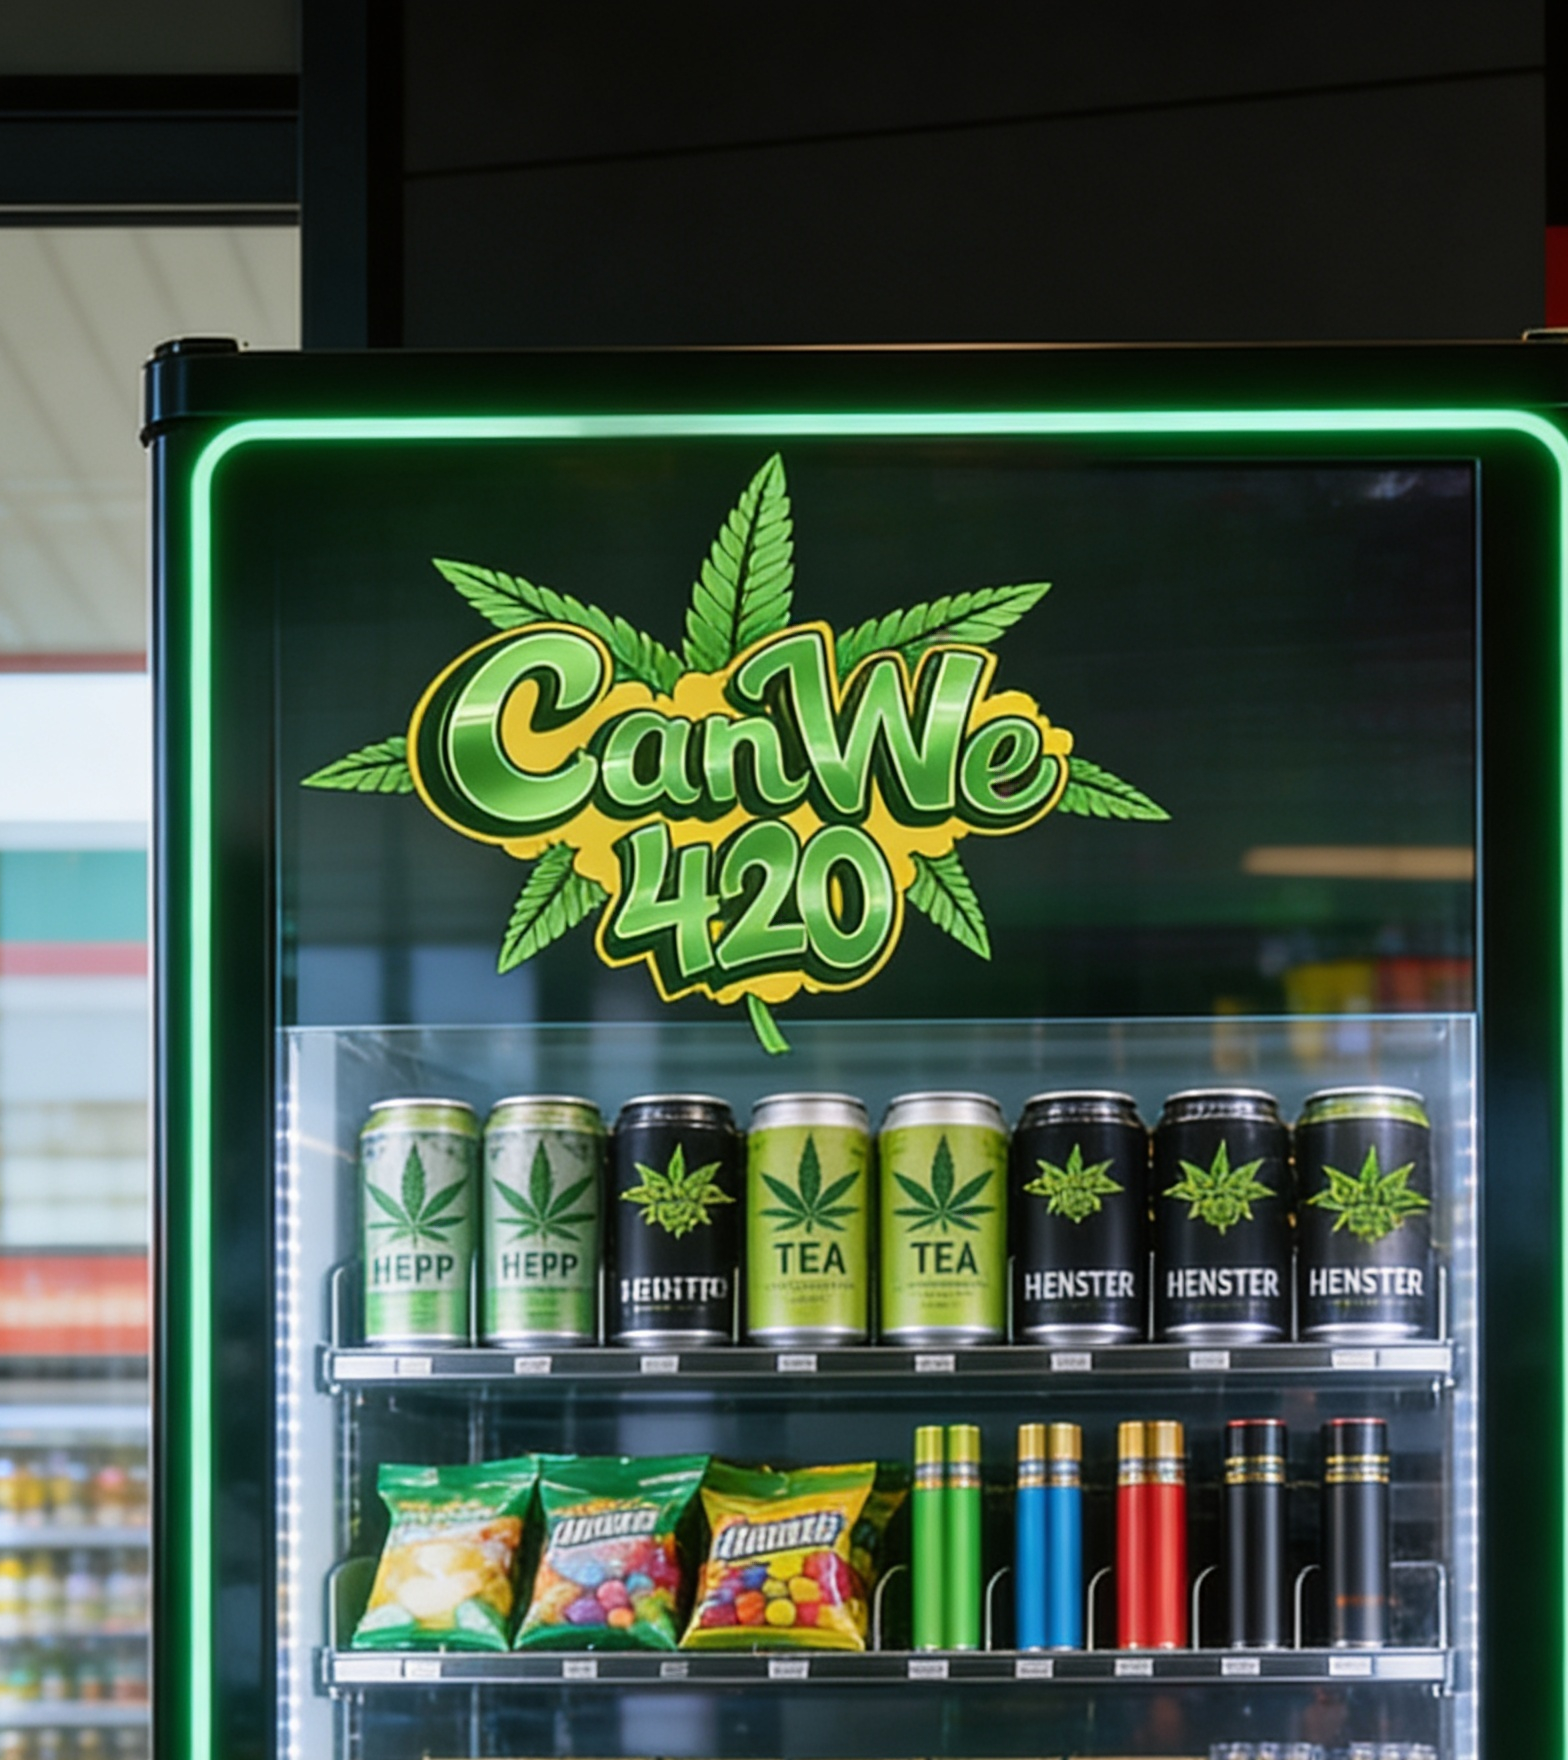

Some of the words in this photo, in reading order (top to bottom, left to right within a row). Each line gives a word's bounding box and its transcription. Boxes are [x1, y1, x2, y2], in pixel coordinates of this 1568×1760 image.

[614, 820, 894, 976] 420
[373, 1253, 455, 1286] HEPP
[501, 1251, 580, 1280] HEPP
[774, 1241, 847, 1275] TEA
[910, 1240, 979, 1275] TEA
[1024, 1269, 1136, 1301] HENSTER
[1166, 1266, 1280, 1298] HENSTER
[1309, 1265, 1425, 1297] HENSTER
